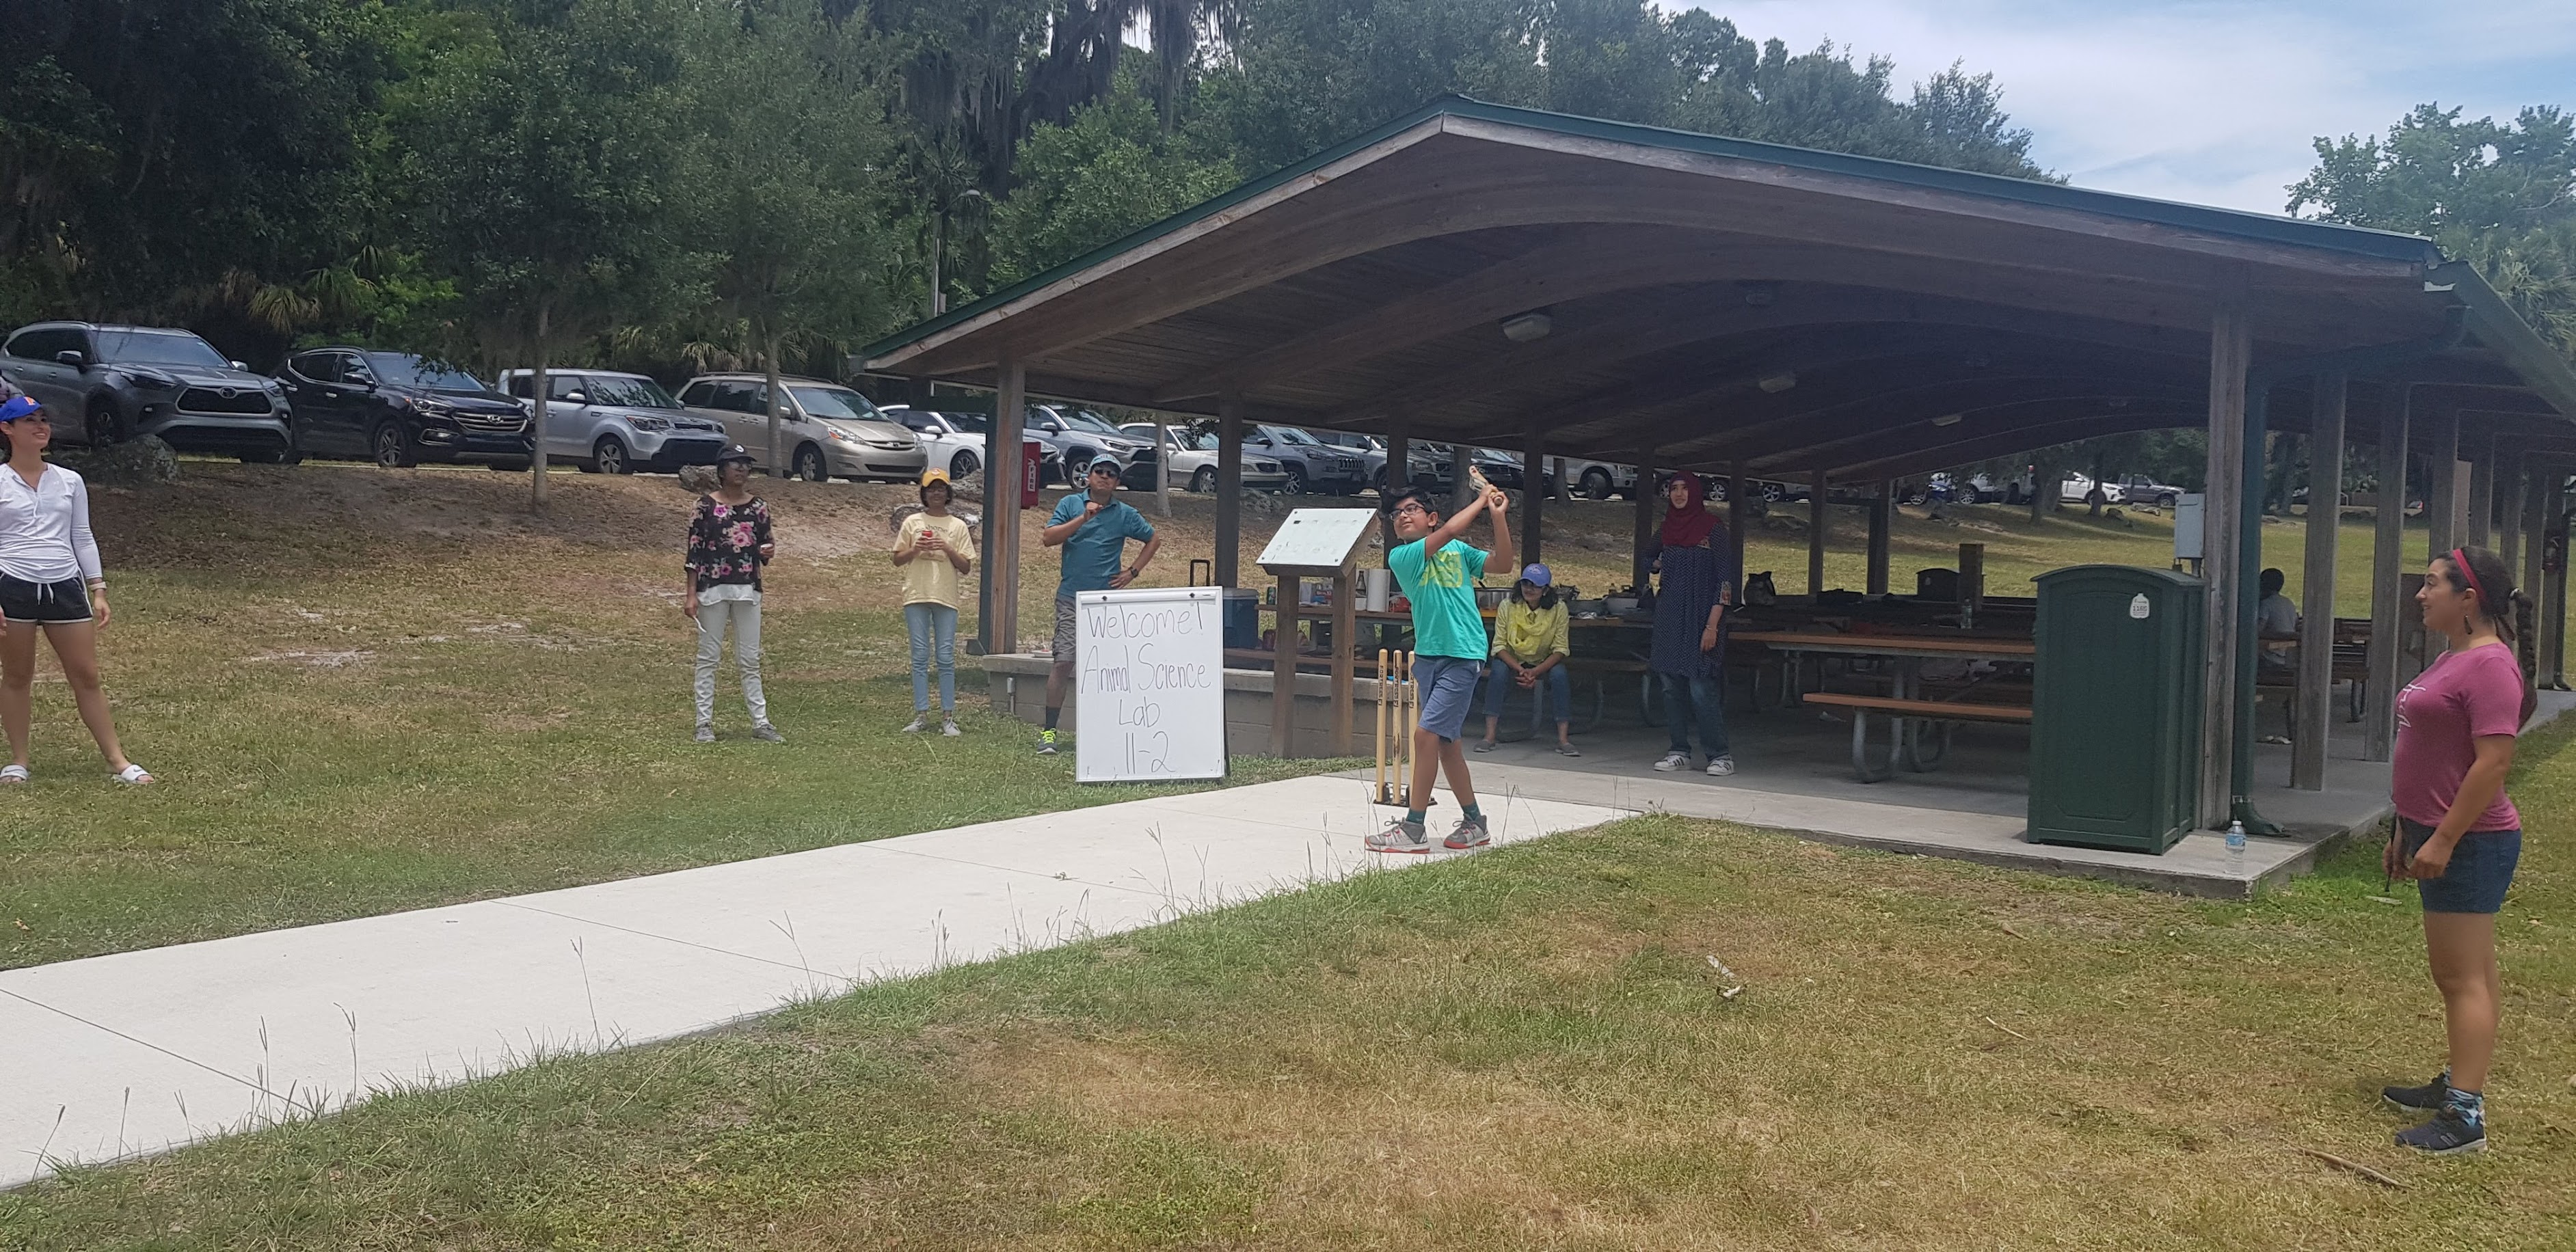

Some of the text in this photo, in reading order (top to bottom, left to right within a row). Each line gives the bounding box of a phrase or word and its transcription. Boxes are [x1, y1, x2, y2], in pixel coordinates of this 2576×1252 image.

[1087, 601, 1203, 639] Welcome!
[1082, 643, 1211, 694] Animal Science
[1118, 696, 1160, 728] Lab
[1125, 731, 1176, 774] 11-2
